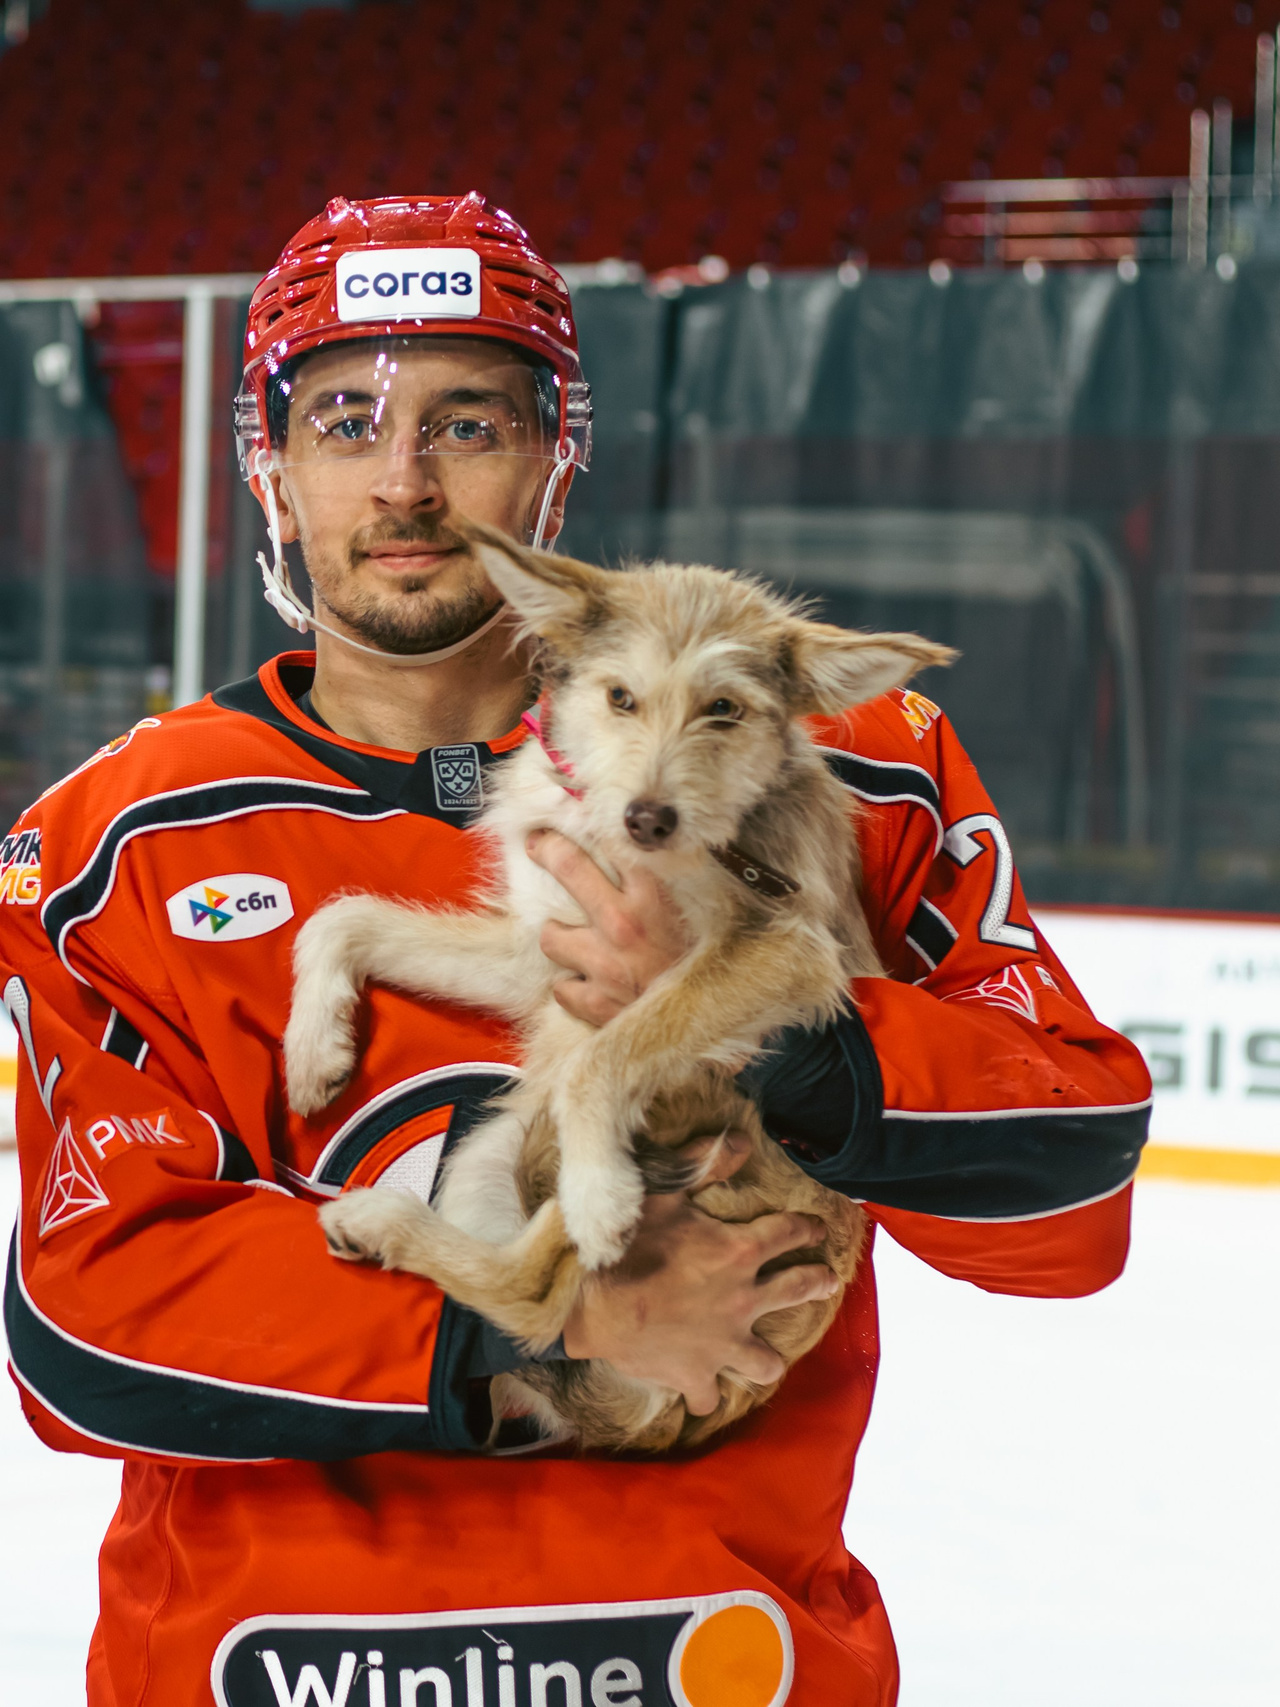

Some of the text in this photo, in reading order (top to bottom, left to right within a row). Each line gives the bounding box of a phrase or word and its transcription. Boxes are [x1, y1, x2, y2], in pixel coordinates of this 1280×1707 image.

[344, 271, 473, 299] согаз
[438, 748, 471, 757] FONBET
[235, 892, 277, 912] сбп
[261, 1645, 644, 1707] Winline
